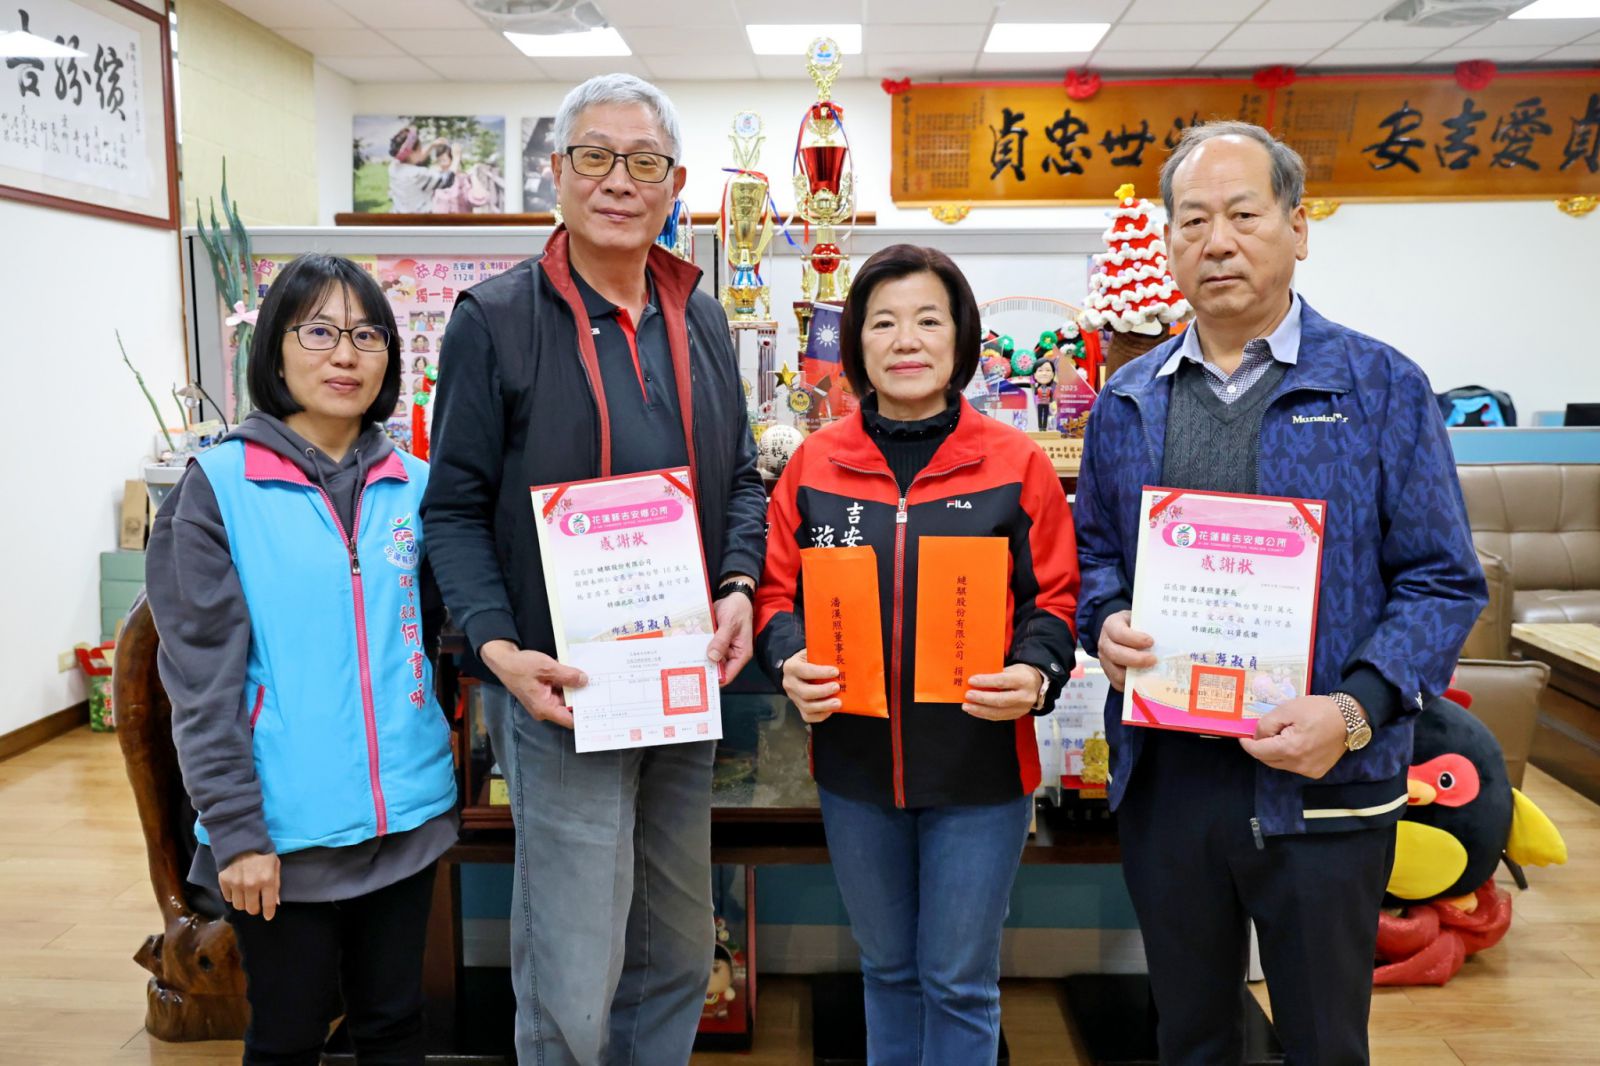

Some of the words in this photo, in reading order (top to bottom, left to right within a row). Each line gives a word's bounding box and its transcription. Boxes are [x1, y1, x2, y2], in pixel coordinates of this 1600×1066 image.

[416, 286, 461, 303] 獨一無
[947, 499, 972, 508] FILA
[592, 506, 668, 524] 花蓮縣吉安鄉公所
[841, 502, 864, 547] 吉安
[601, 531, 647, 550] 感謝狀
[1199, 531, 1287, 548] 花蓮縣吉安鄉公所
[1201, 554, 1255, 575] 感謝狀
[831, 597, 845, 664] 潘漢照董事長
